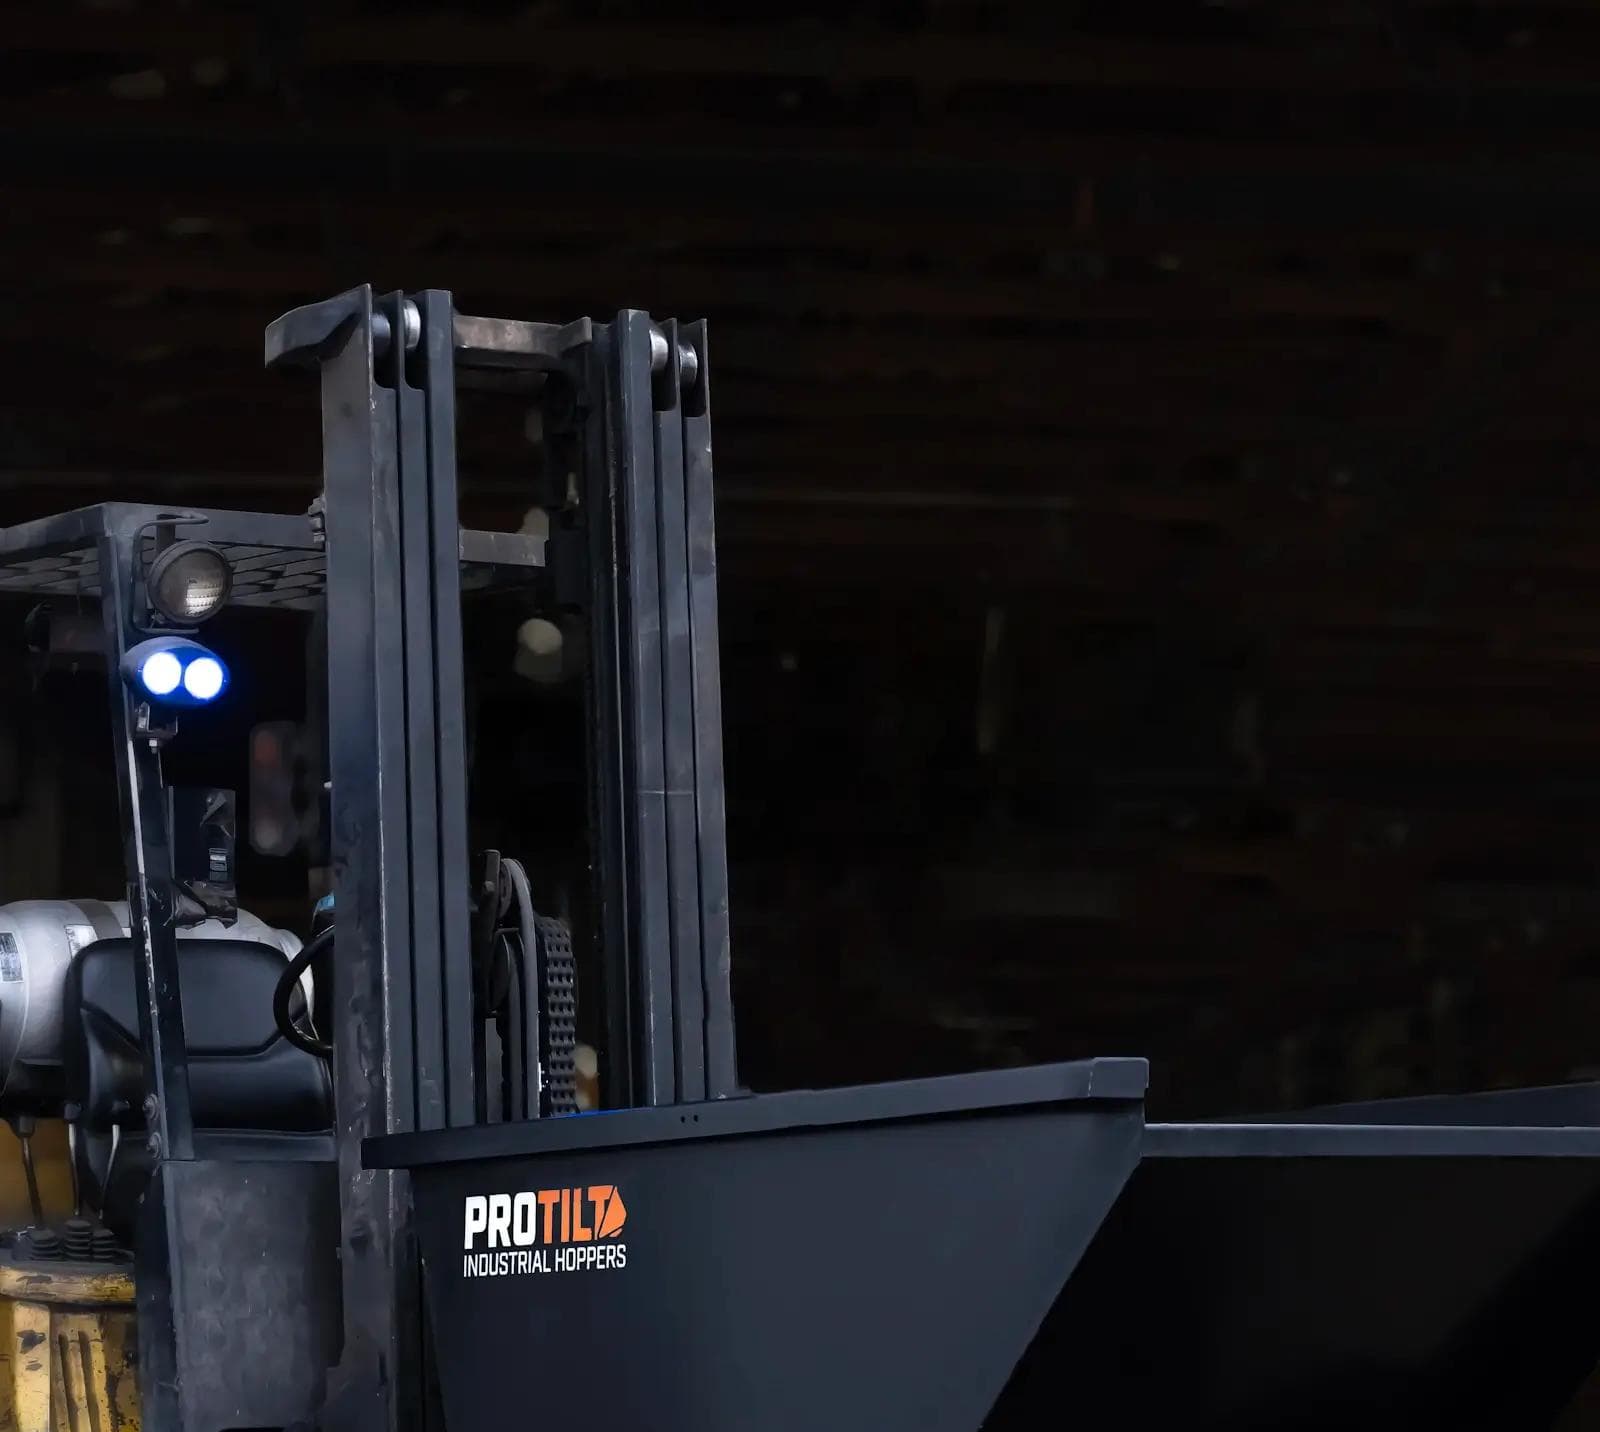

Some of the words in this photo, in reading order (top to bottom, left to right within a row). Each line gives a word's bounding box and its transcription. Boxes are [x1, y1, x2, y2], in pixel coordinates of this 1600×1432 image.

[464, 1184, 614, 1250] PROTILT
[463, 1250, 552, 1277] INDUSTRIAL
[555, 1244, 627, 1272] HOPPERS
